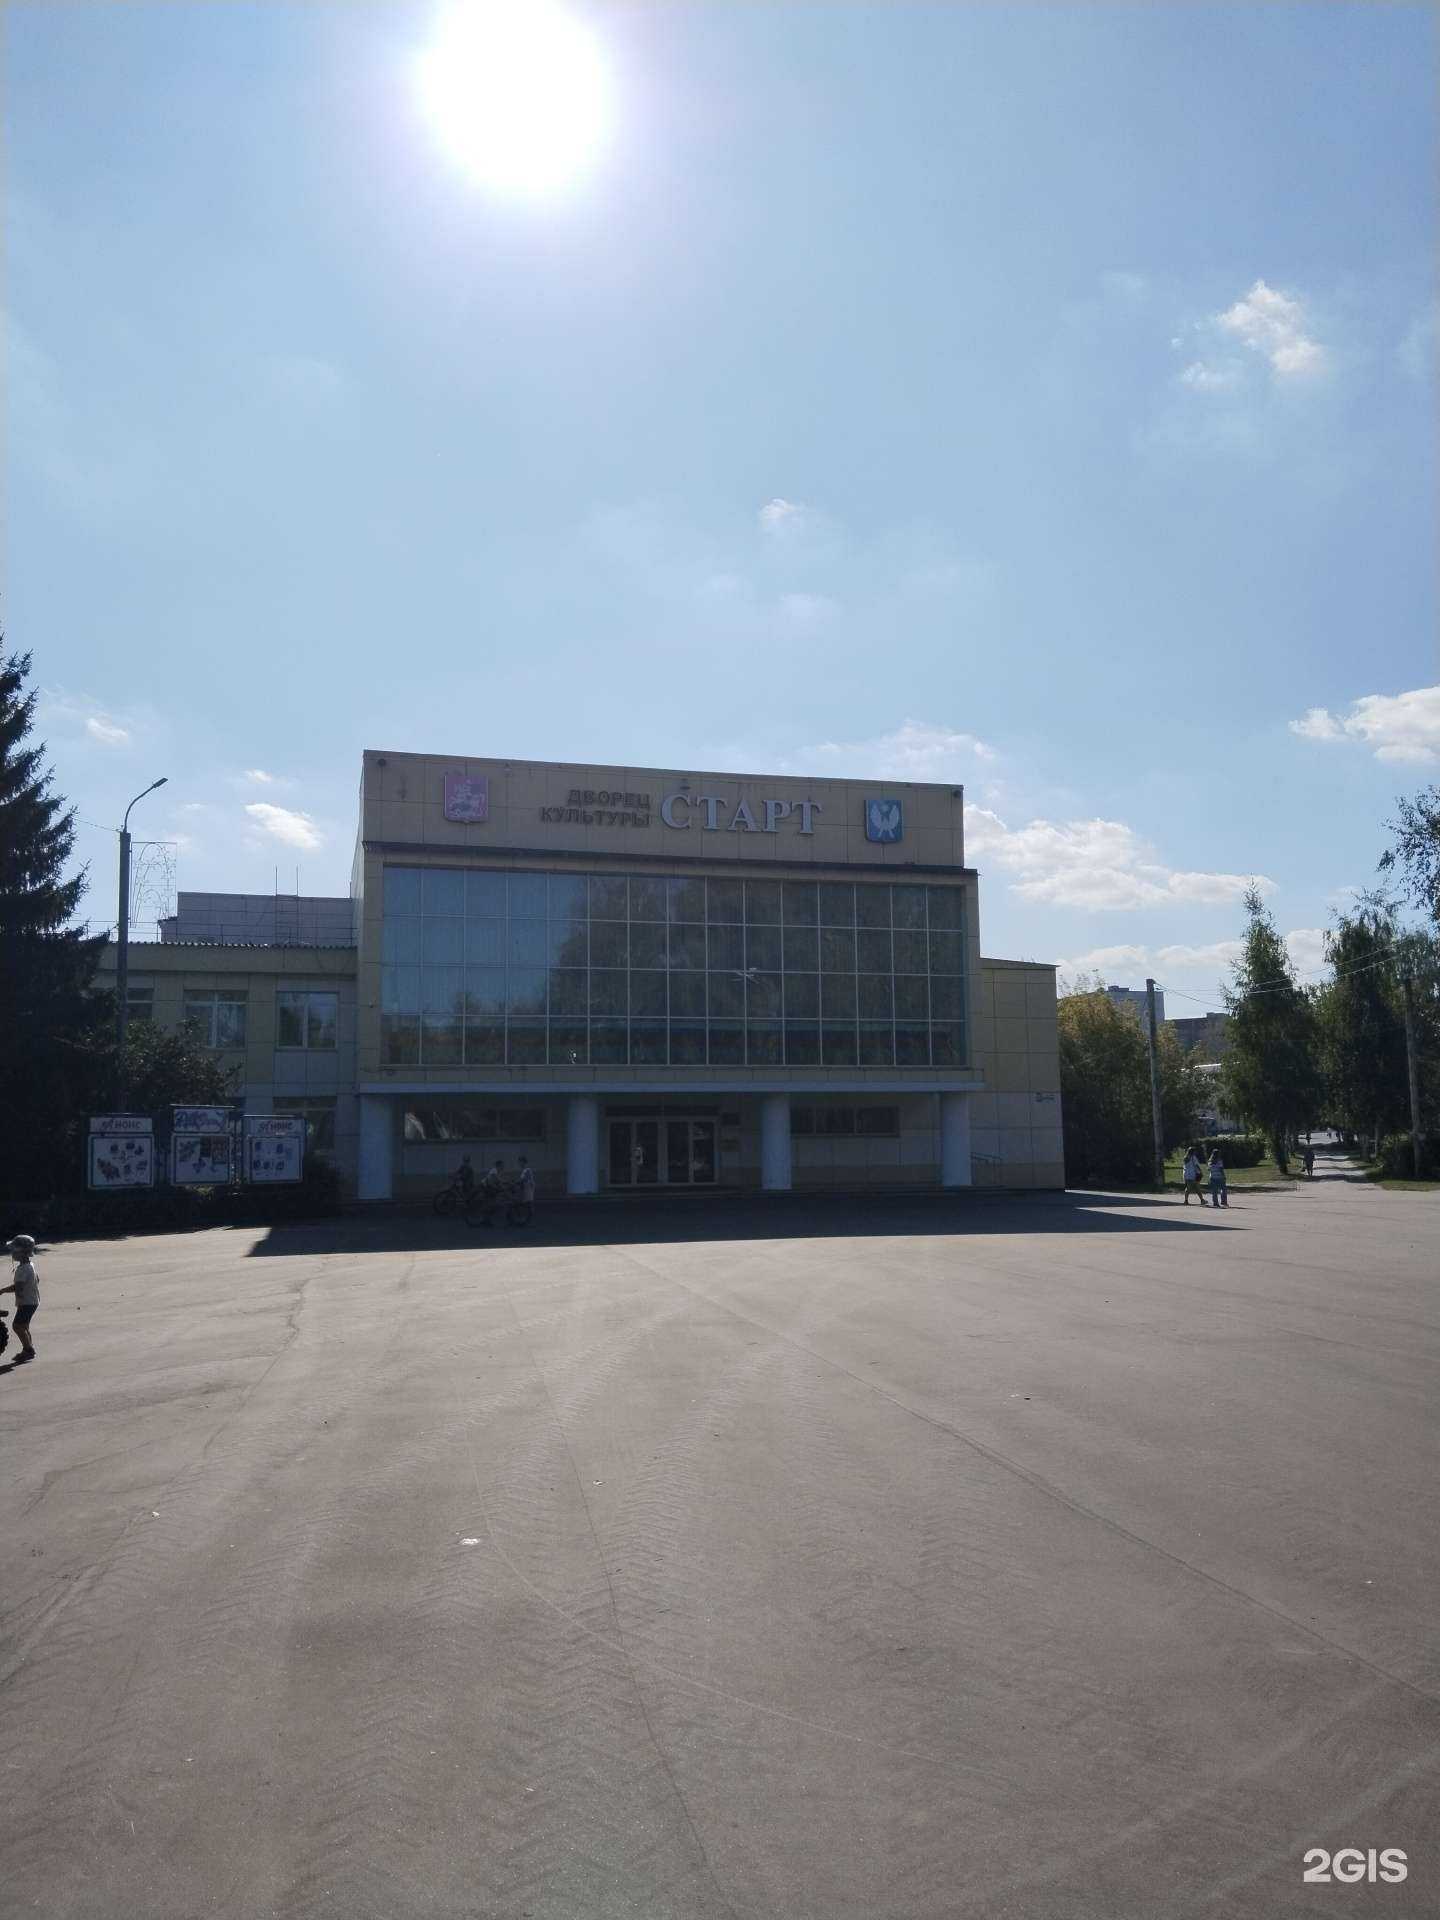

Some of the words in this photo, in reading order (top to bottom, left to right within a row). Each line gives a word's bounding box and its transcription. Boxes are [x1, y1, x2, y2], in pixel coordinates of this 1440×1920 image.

[567, 788, 651, 809] ДВОРЕЦ
[540, 807, 651, 828] КУЛЬТУРЫ
[660, 793, 822, 835] СТАРТ
